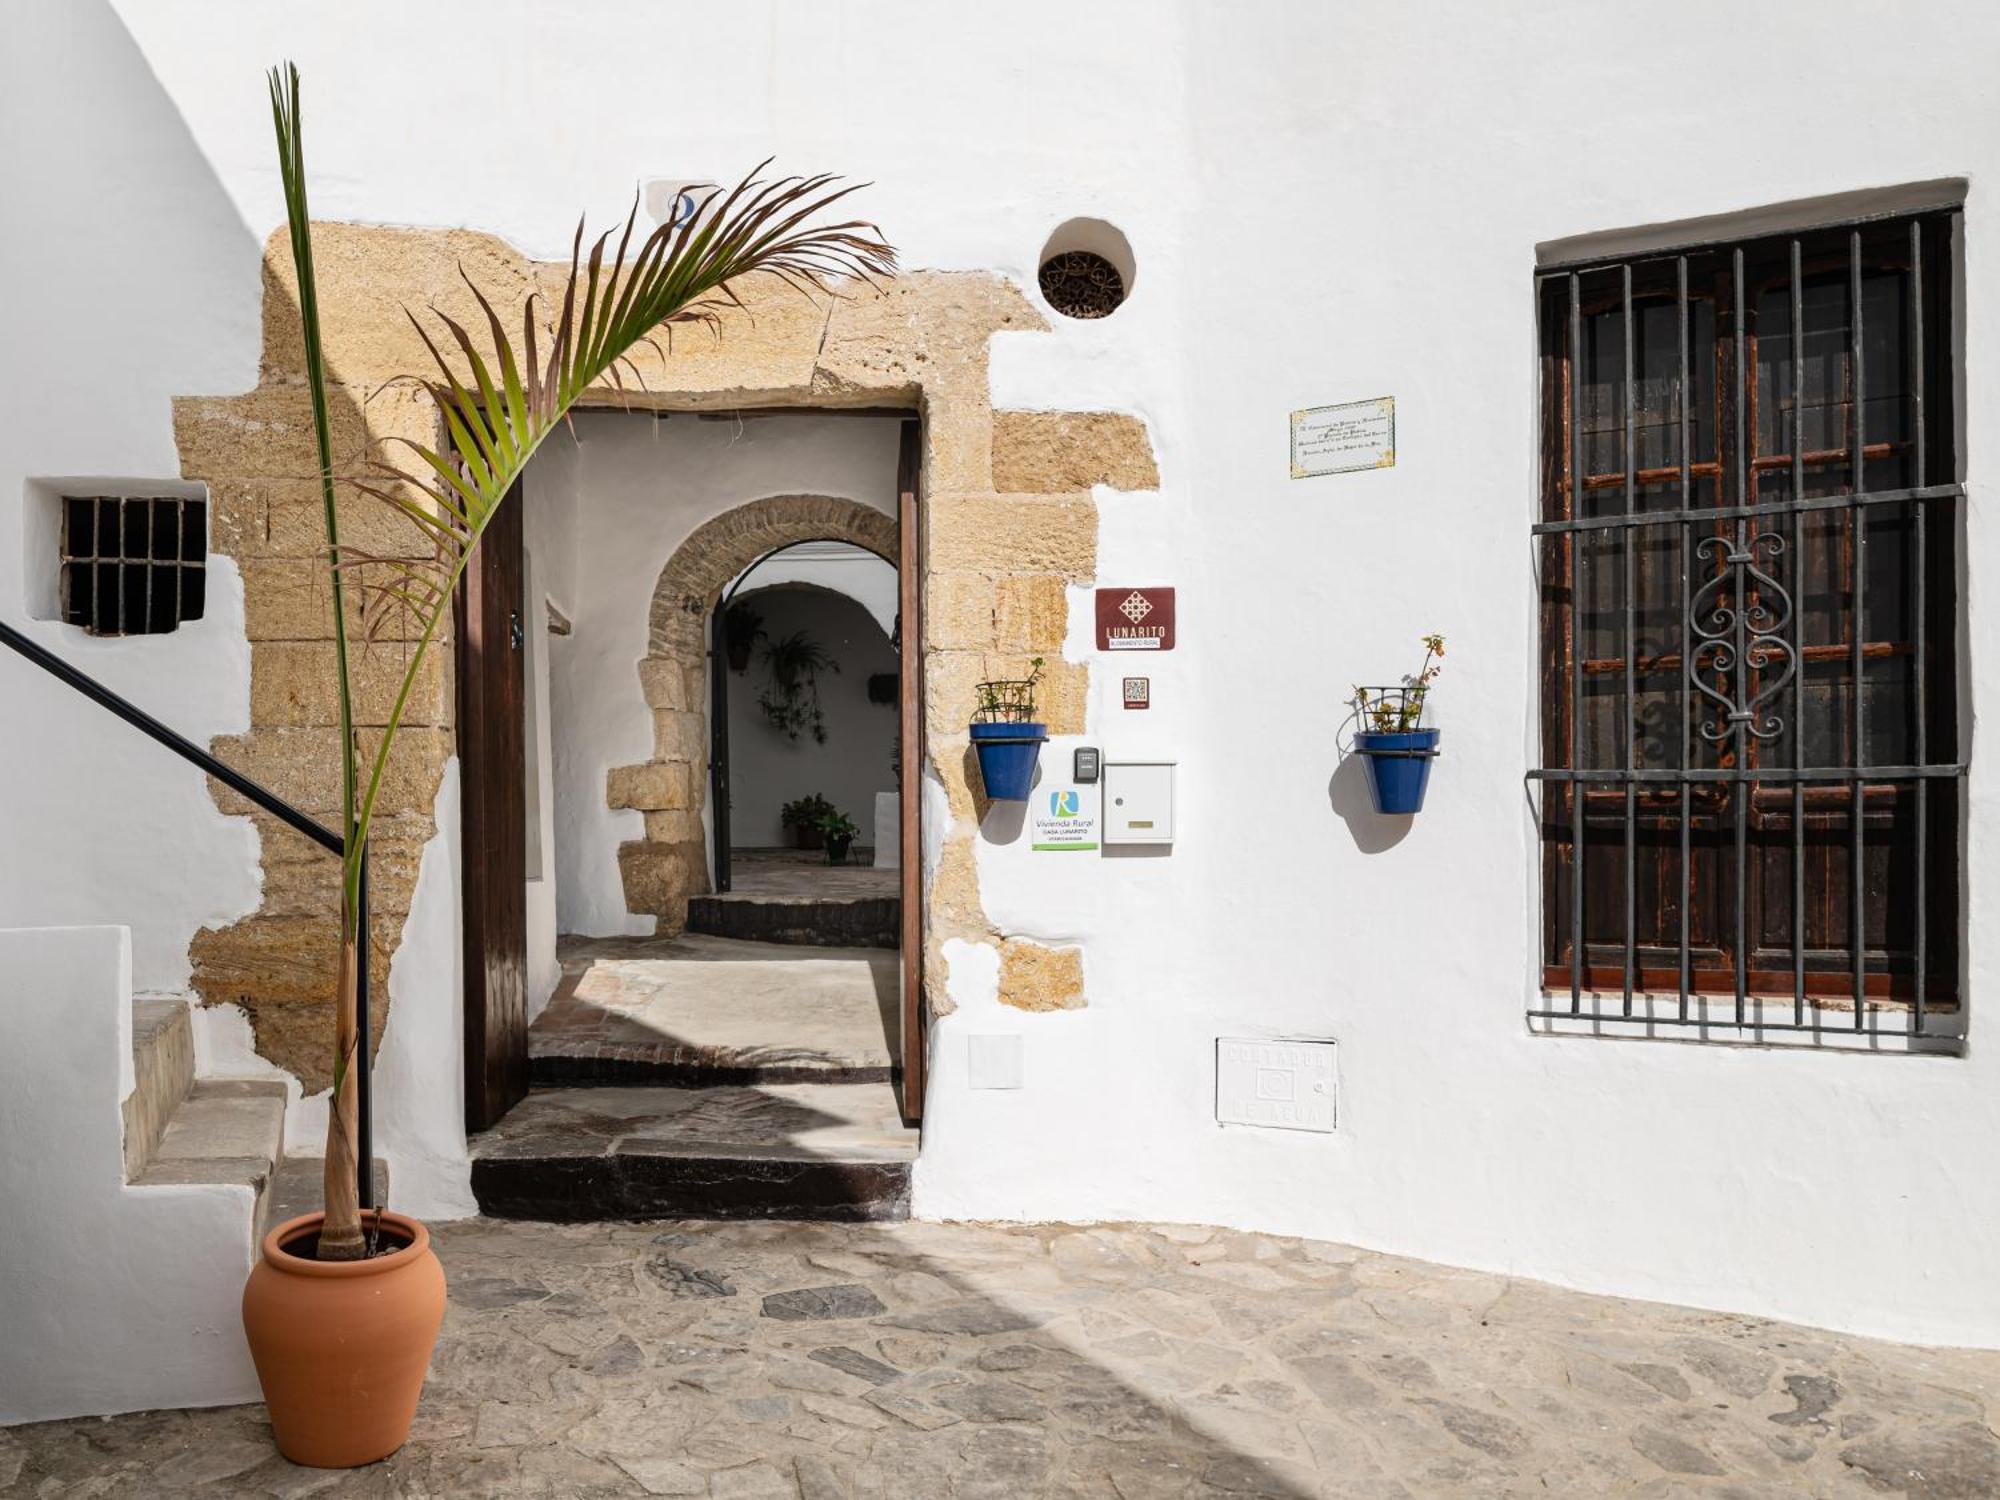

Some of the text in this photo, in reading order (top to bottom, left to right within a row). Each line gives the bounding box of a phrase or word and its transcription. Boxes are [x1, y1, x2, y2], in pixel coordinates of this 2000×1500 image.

[1106, 626, 1165, 639] LUNARITO
[1036, 818, 1094, 828] Vivienda Rural
